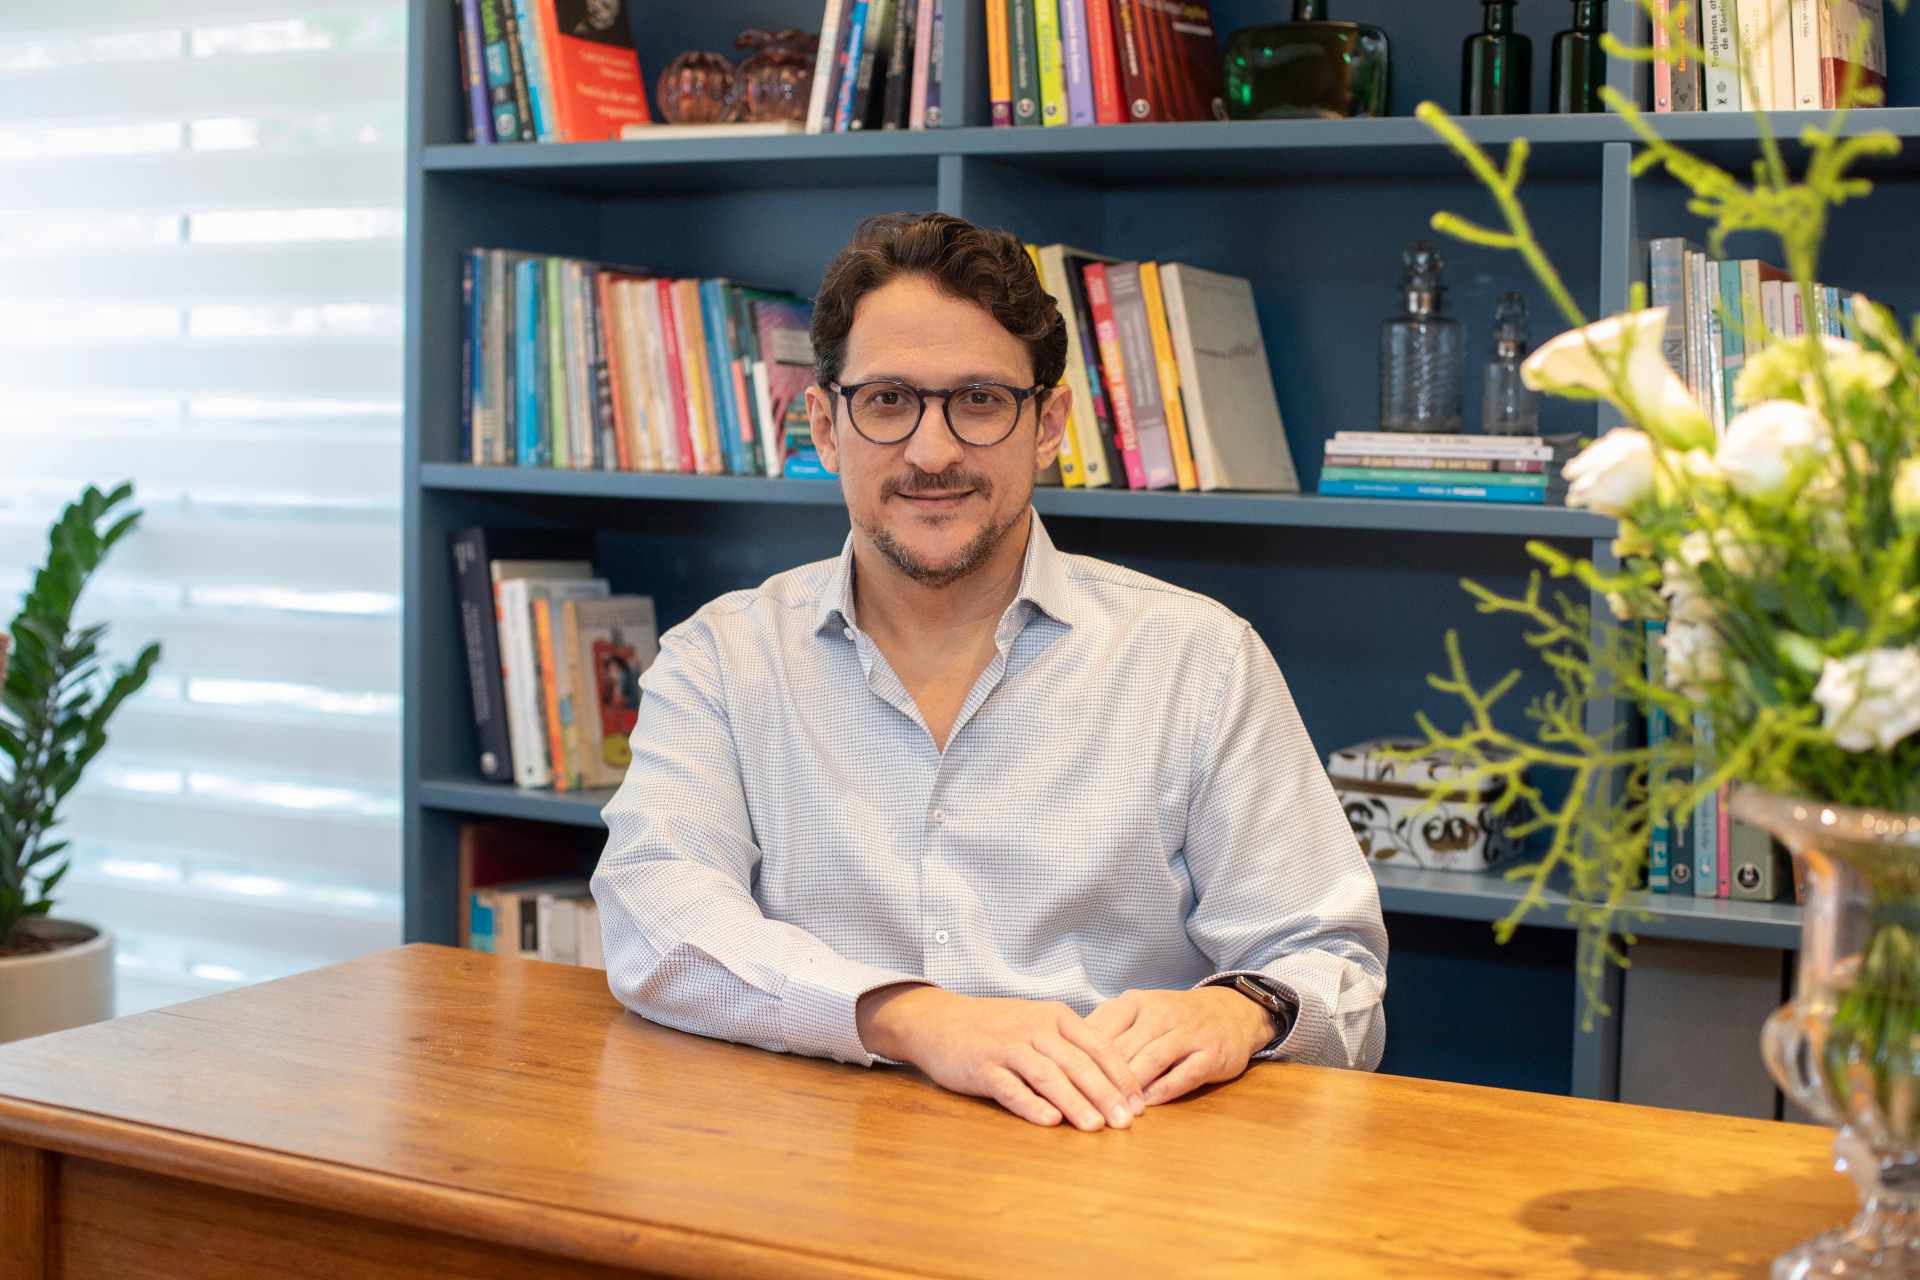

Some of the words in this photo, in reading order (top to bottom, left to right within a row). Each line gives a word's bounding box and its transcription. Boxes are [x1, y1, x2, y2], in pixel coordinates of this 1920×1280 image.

[1718, 0, 1728, 33] Bioétic
[1752, 9, 1760, 18] 21
[1709, 15, 1720, 68] Problemas
[1752, 19, 1761, 44] século
[1720, 37, 1729, 50] de
[1755, 52, 1764, 69] para
